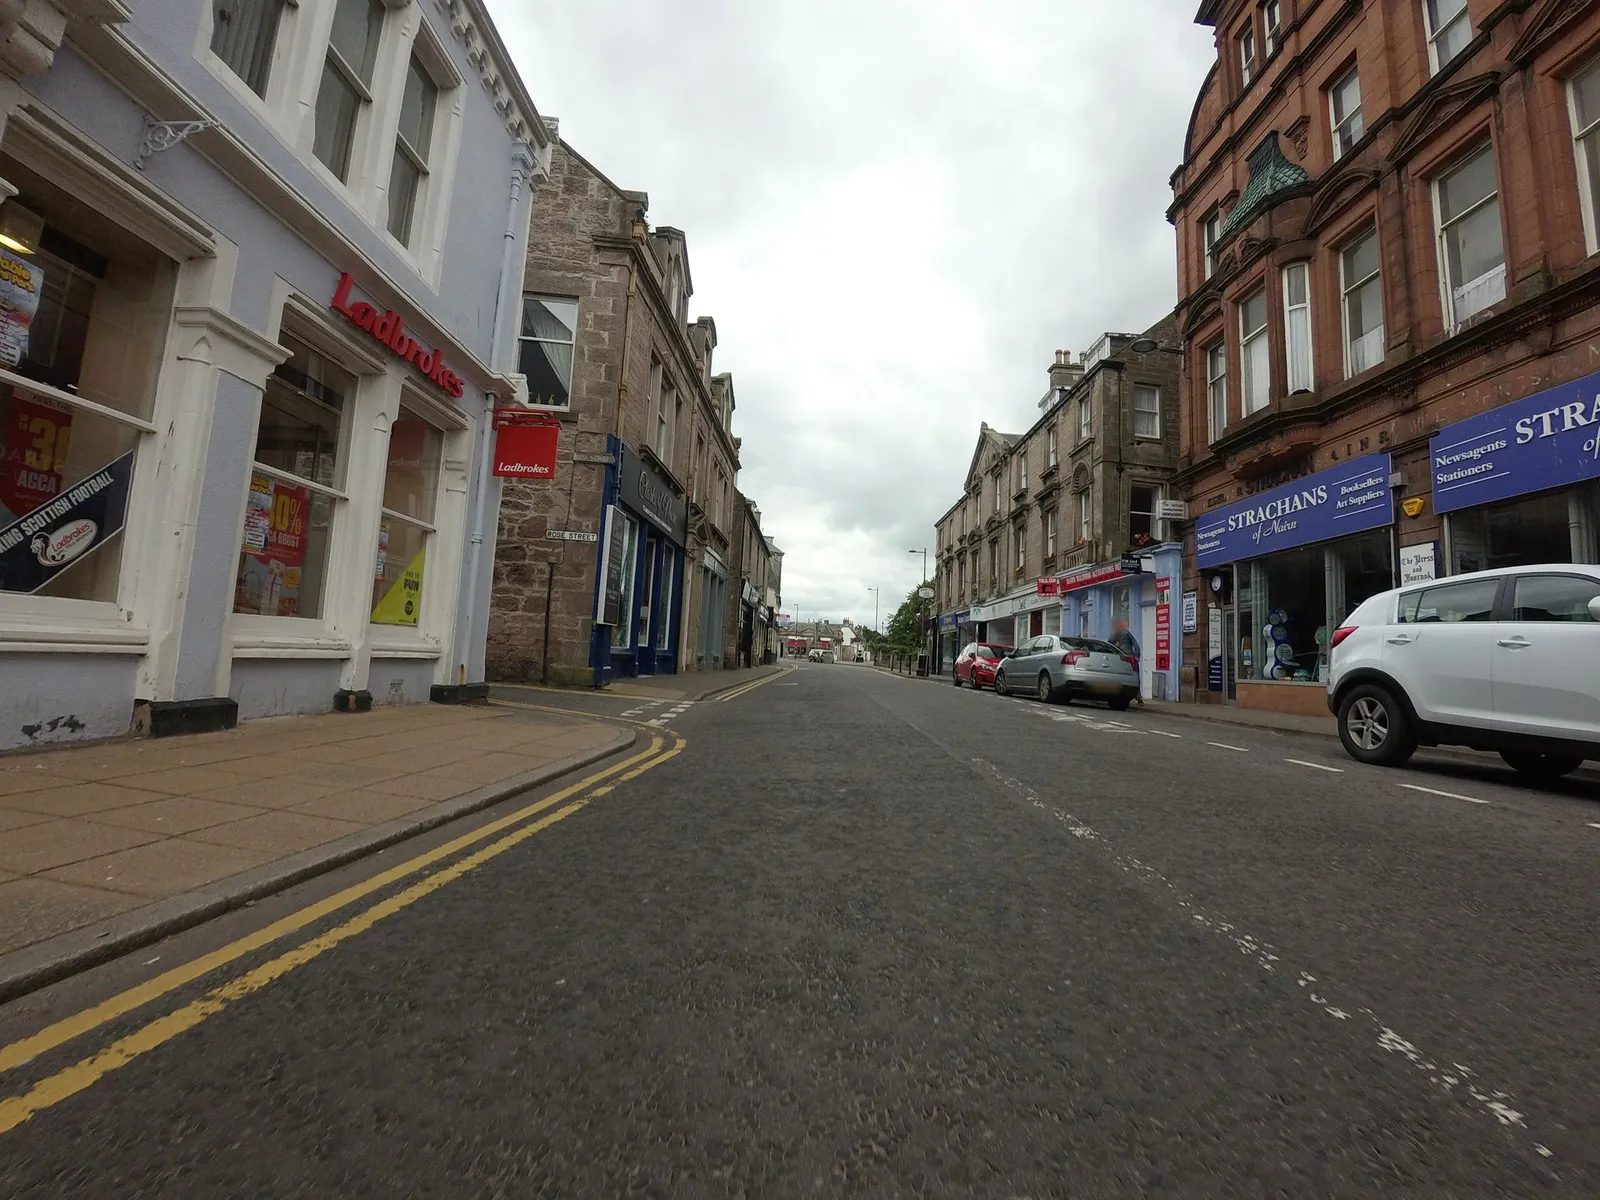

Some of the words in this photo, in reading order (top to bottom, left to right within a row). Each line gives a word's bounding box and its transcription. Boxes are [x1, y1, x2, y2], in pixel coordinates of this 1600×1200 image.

[331, 272, 464, 398] Ladbrokes
[1435, 438, 1507, 468] Newsagents
[498, 462, 549, 474] Ladbrokes
[1436, 461, 1493, 484] Stationers
[16, 469, 57, 494] ACCA
[1340, 476, 1384, 495] Booksellers
[20, 497, 72, 536] SCOTTISH
[69, 470, 114, 506] FOOTBALL
[1228, 485, 1328, 532] STRACHANS
[1336, 498, 1347, 509] Art
[1349, 489, 1384, 506] Suppliers
[52, 522, 90, 551] Ladbrokes
[547, 531, 565, 539] ROSE
[569, 533, 596, 541] STREET
[1197, 526, 1226, 541] Newsagents
[1252, 522, 1262, 544] of
[1263, 519, 1297, 536] Nairn
[1197, 540, 1220, 551] Stationers
[1413, 565, 1422, 573] and
[1414, 554, 1434, 566] Press
[404, 578, 419, 591] FUN
[1404, 571, 1430, 584] Journal
